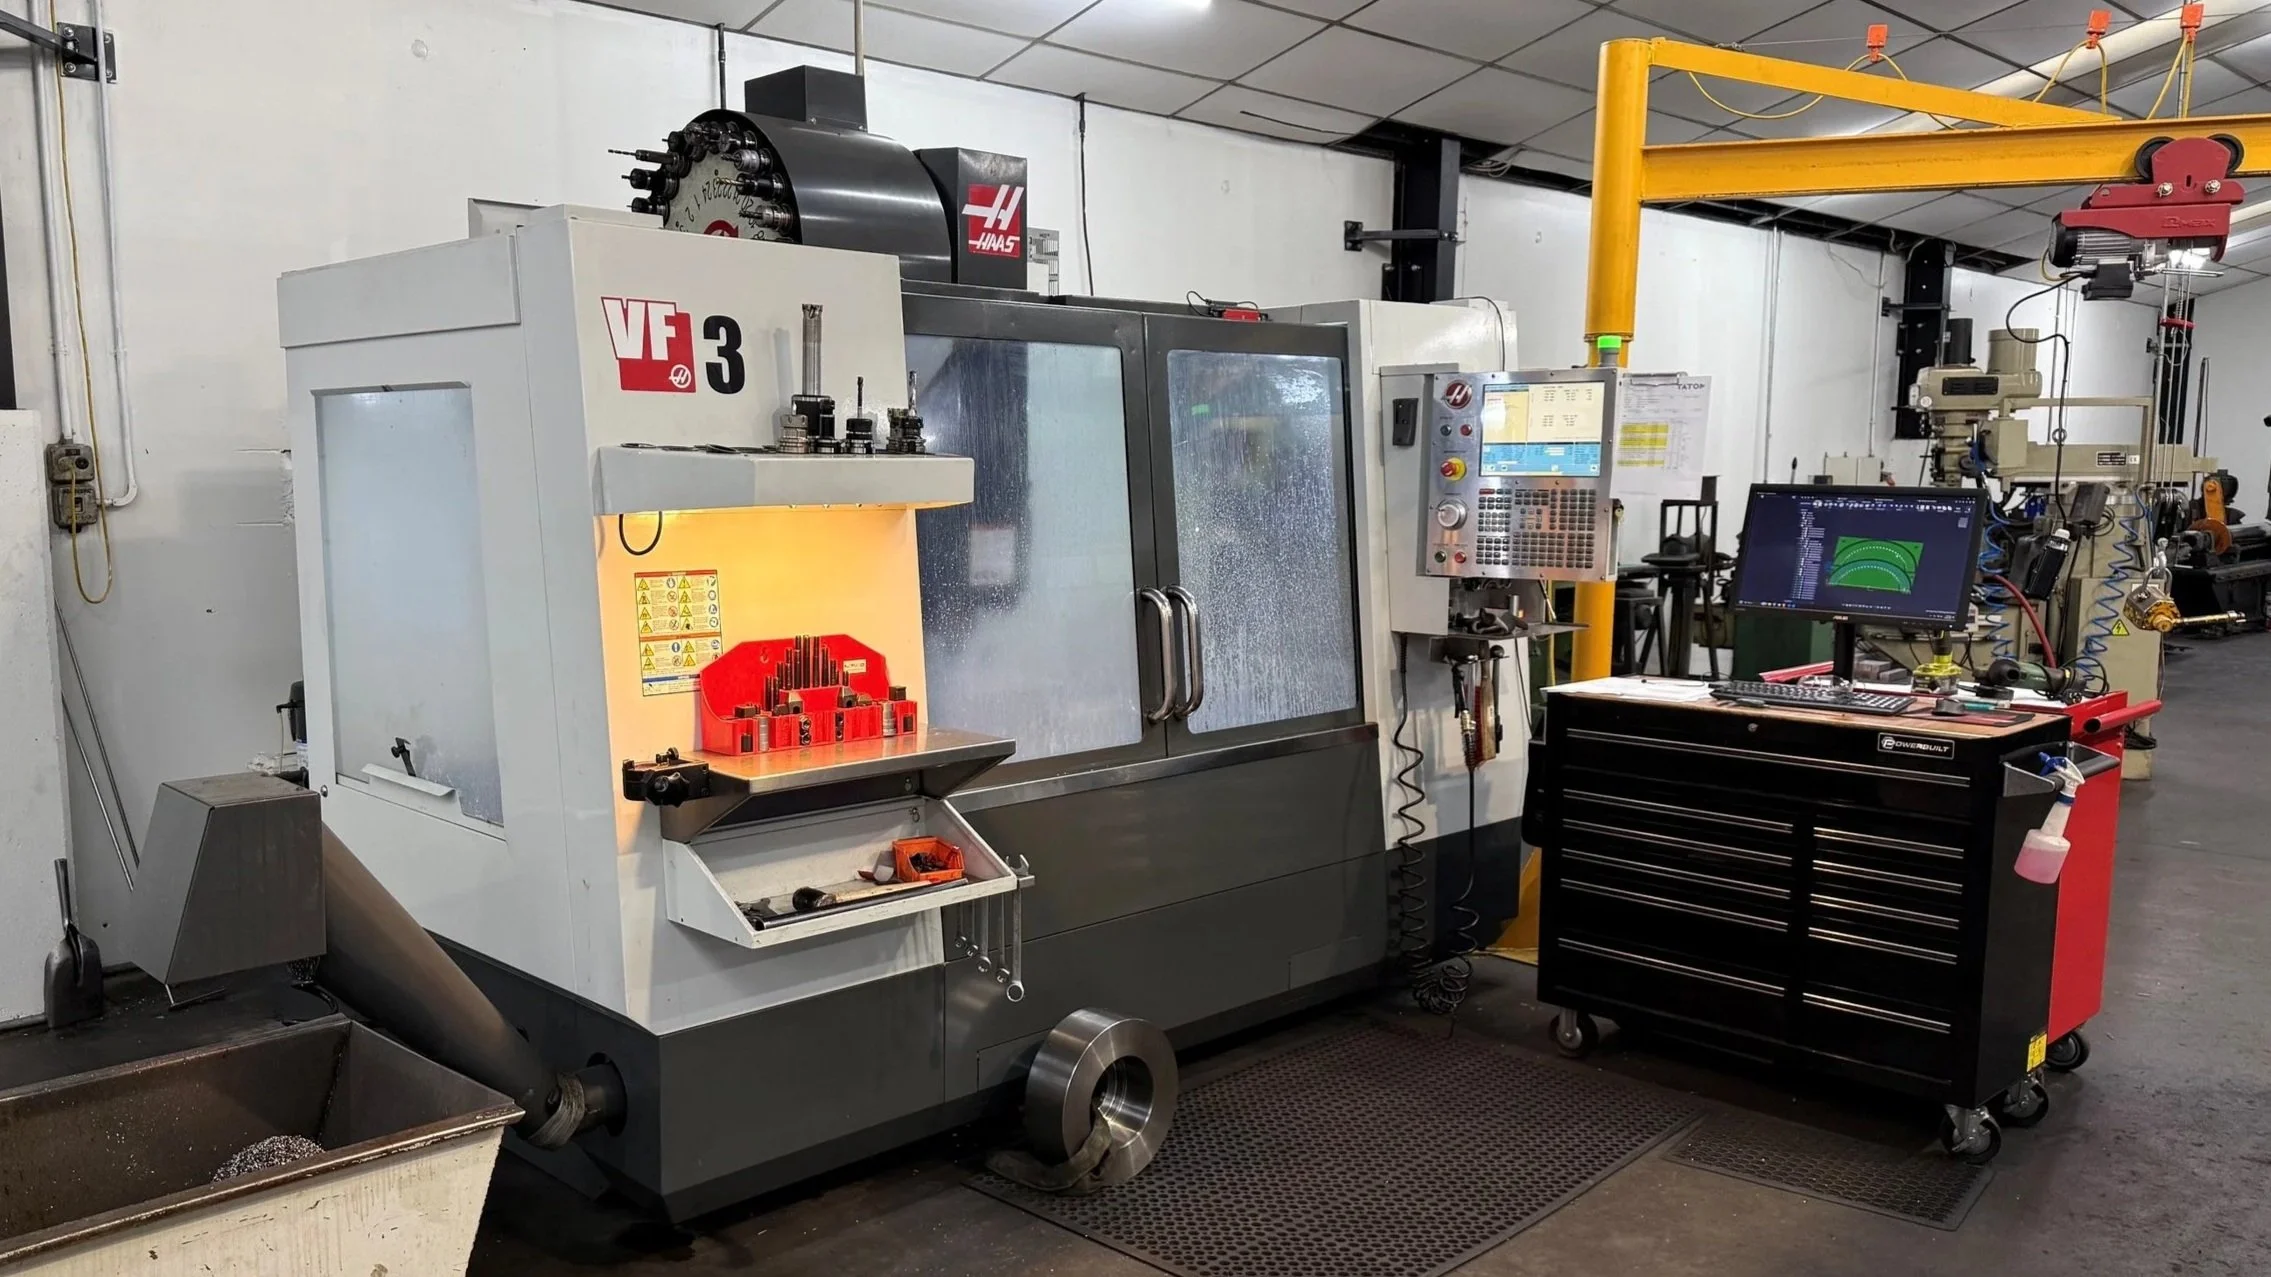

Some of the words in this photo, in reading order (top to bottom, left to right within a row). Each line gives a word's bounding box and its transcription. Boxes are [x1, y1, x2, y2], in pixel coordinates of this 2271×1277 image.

[968, 232, 1020, 253] HAAS
[601, 297, 677, 361] VF
[703, 315, 746, 394] 3
